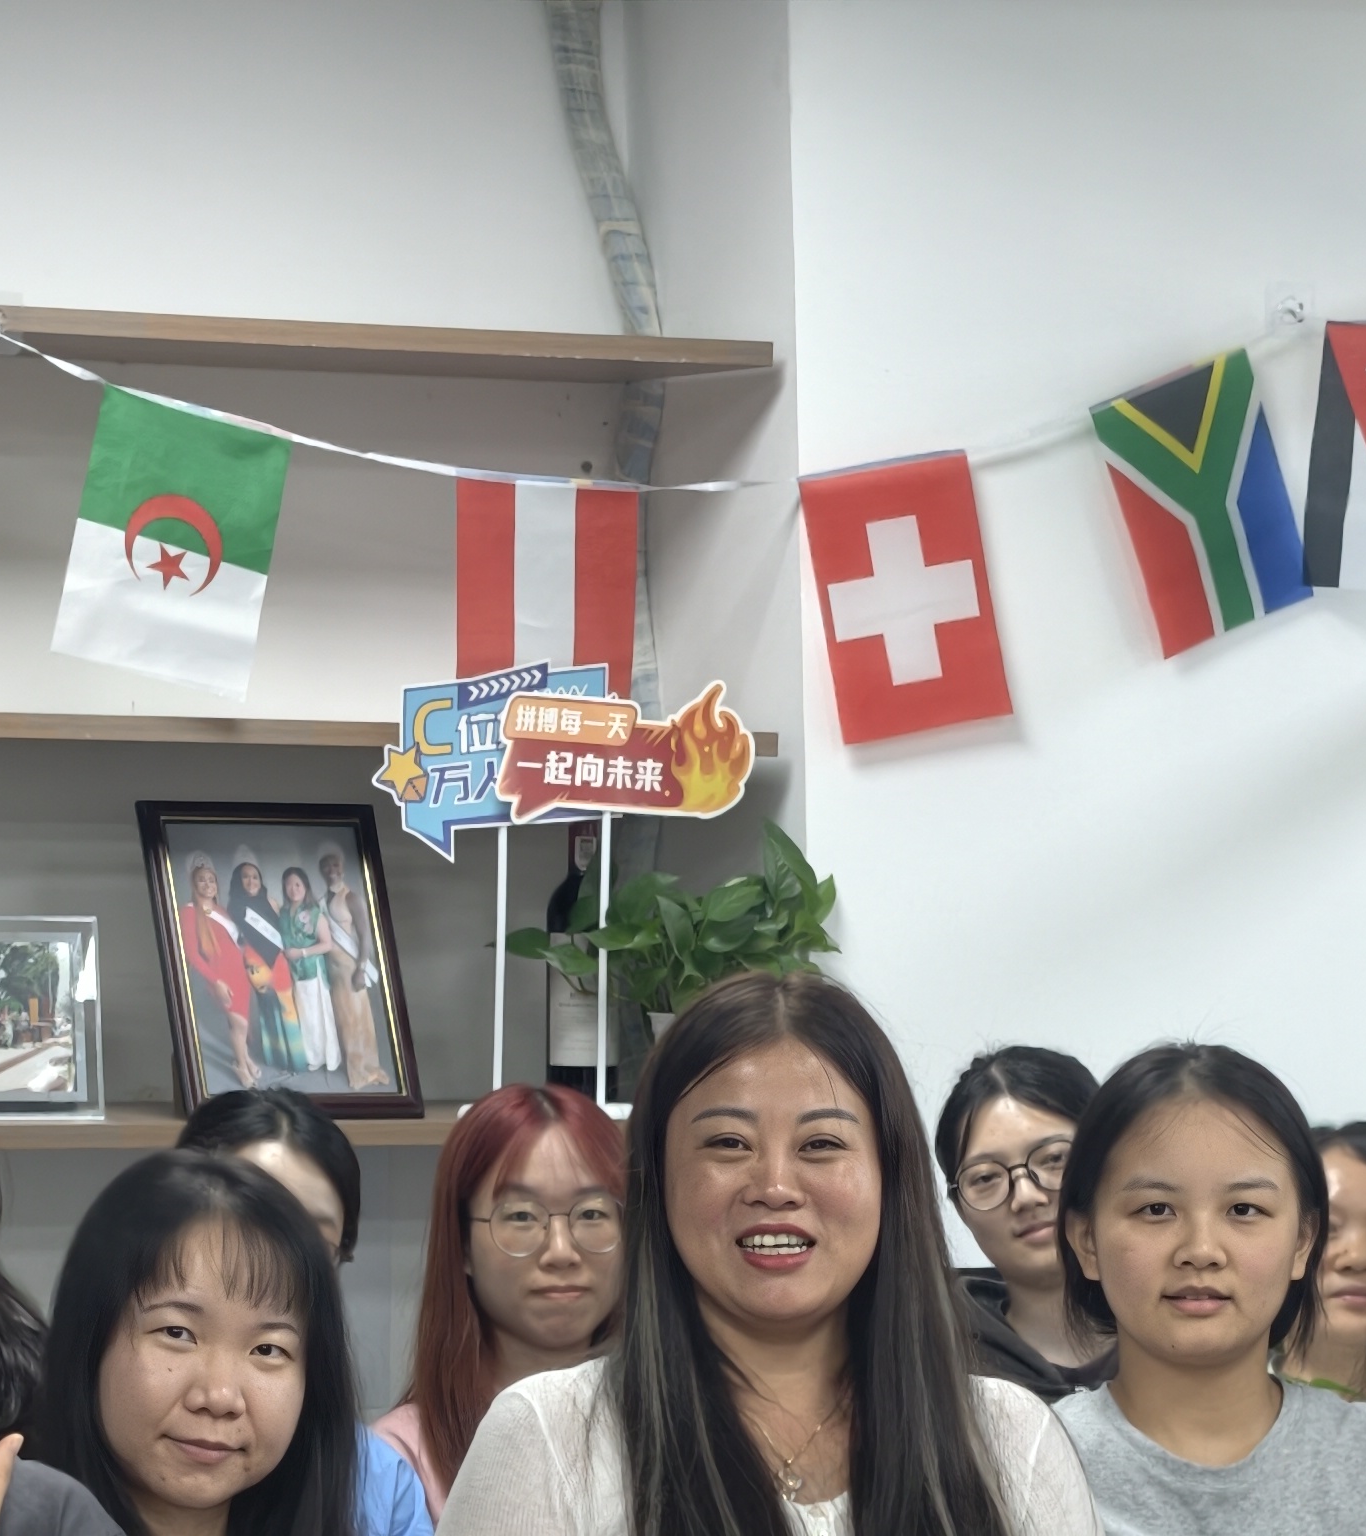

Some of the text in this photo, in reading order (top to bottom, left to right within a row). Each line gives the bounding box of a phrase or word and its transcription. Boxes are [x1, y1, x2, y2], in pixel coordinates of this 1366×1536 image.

[413, 699, 505, 756] C位
[515, 705, 628, 740] 拼搏每一天
[517, 750, 664, 793] 一起向未来
